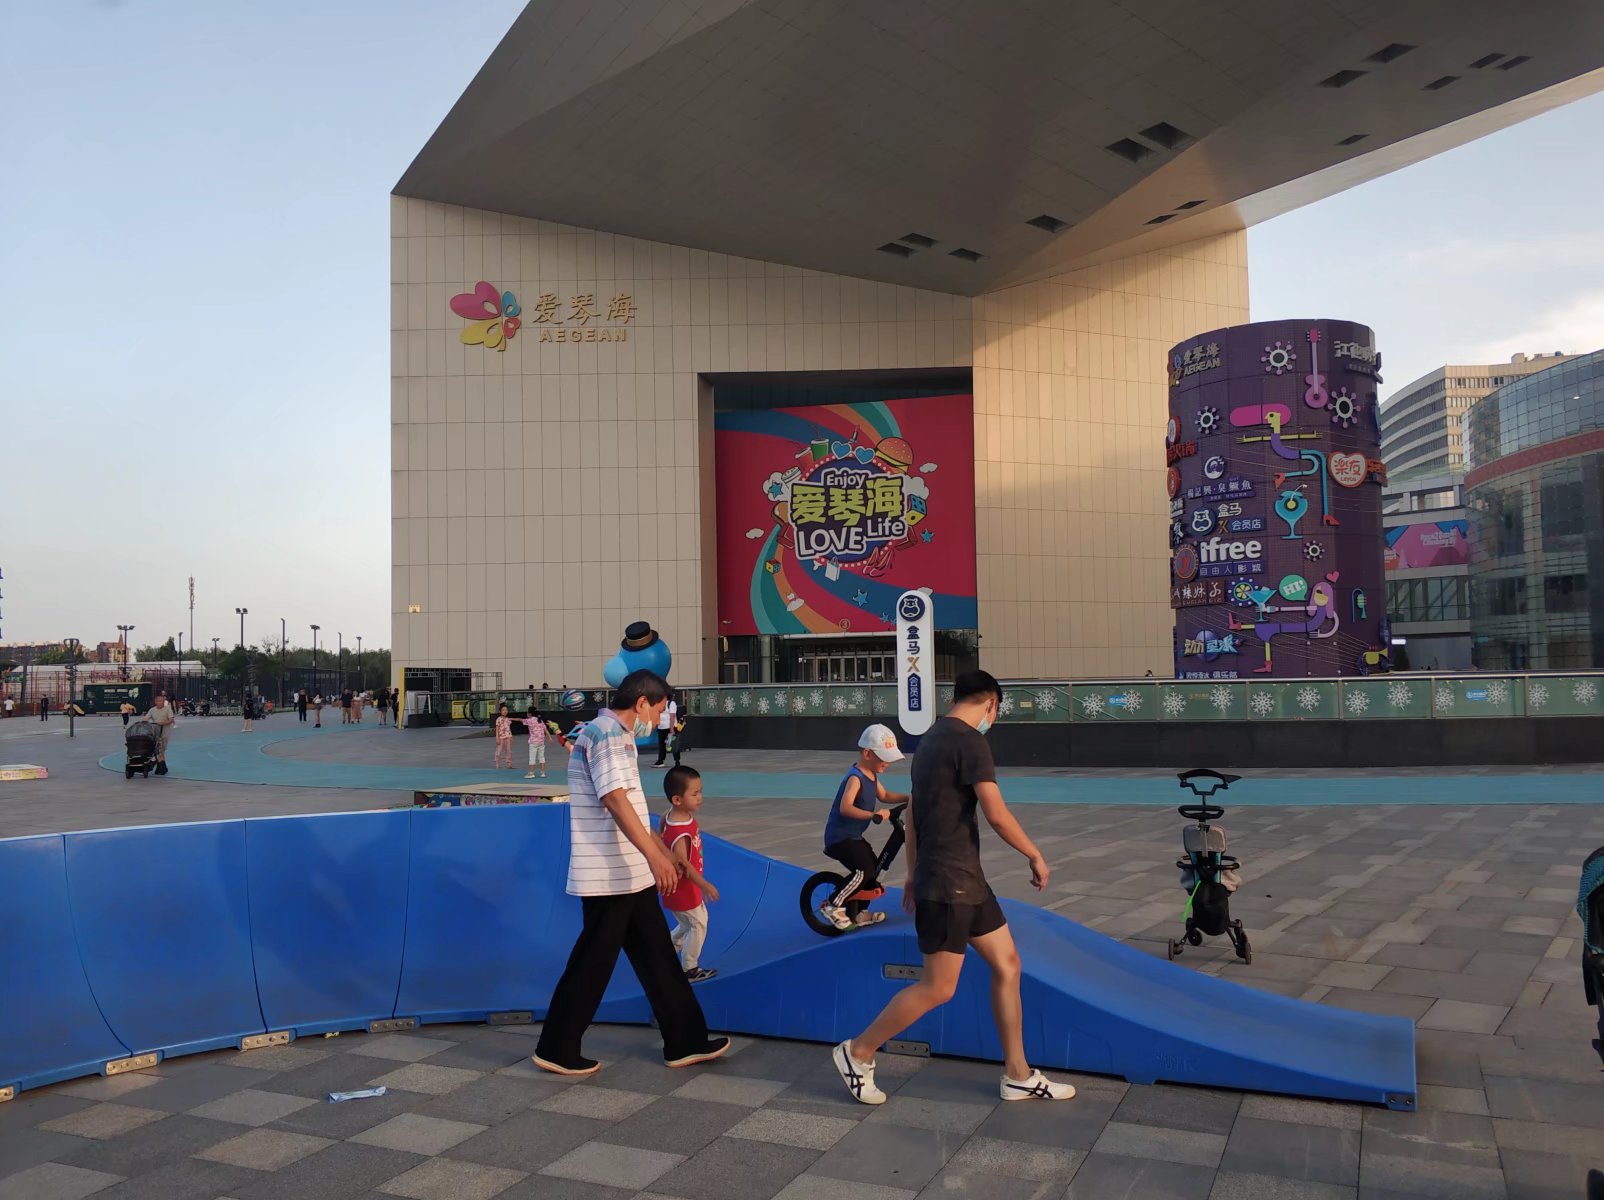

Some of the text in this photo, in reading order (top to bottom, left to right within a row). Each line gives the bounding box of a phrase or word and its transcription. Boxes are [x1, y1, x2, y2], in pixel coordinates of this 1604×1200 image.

[532, 293, 638, 325] 爱琴海
[539, 329, 627, 343] AEGEAN
[1184, 357, 1221, 376] AEGEAN
[826, 473, 867, 489] Enjoy
[791, 477, 905, 526] 爱琴海
[1217, 502, 1242, 518] 盒马
[1232, 519, 1262, 531] 会员店
[797, 518, 906, 557] LOVE Life
[907, 625, 921, 655] 盒马
[908, 676, 920, 708] 会员店
